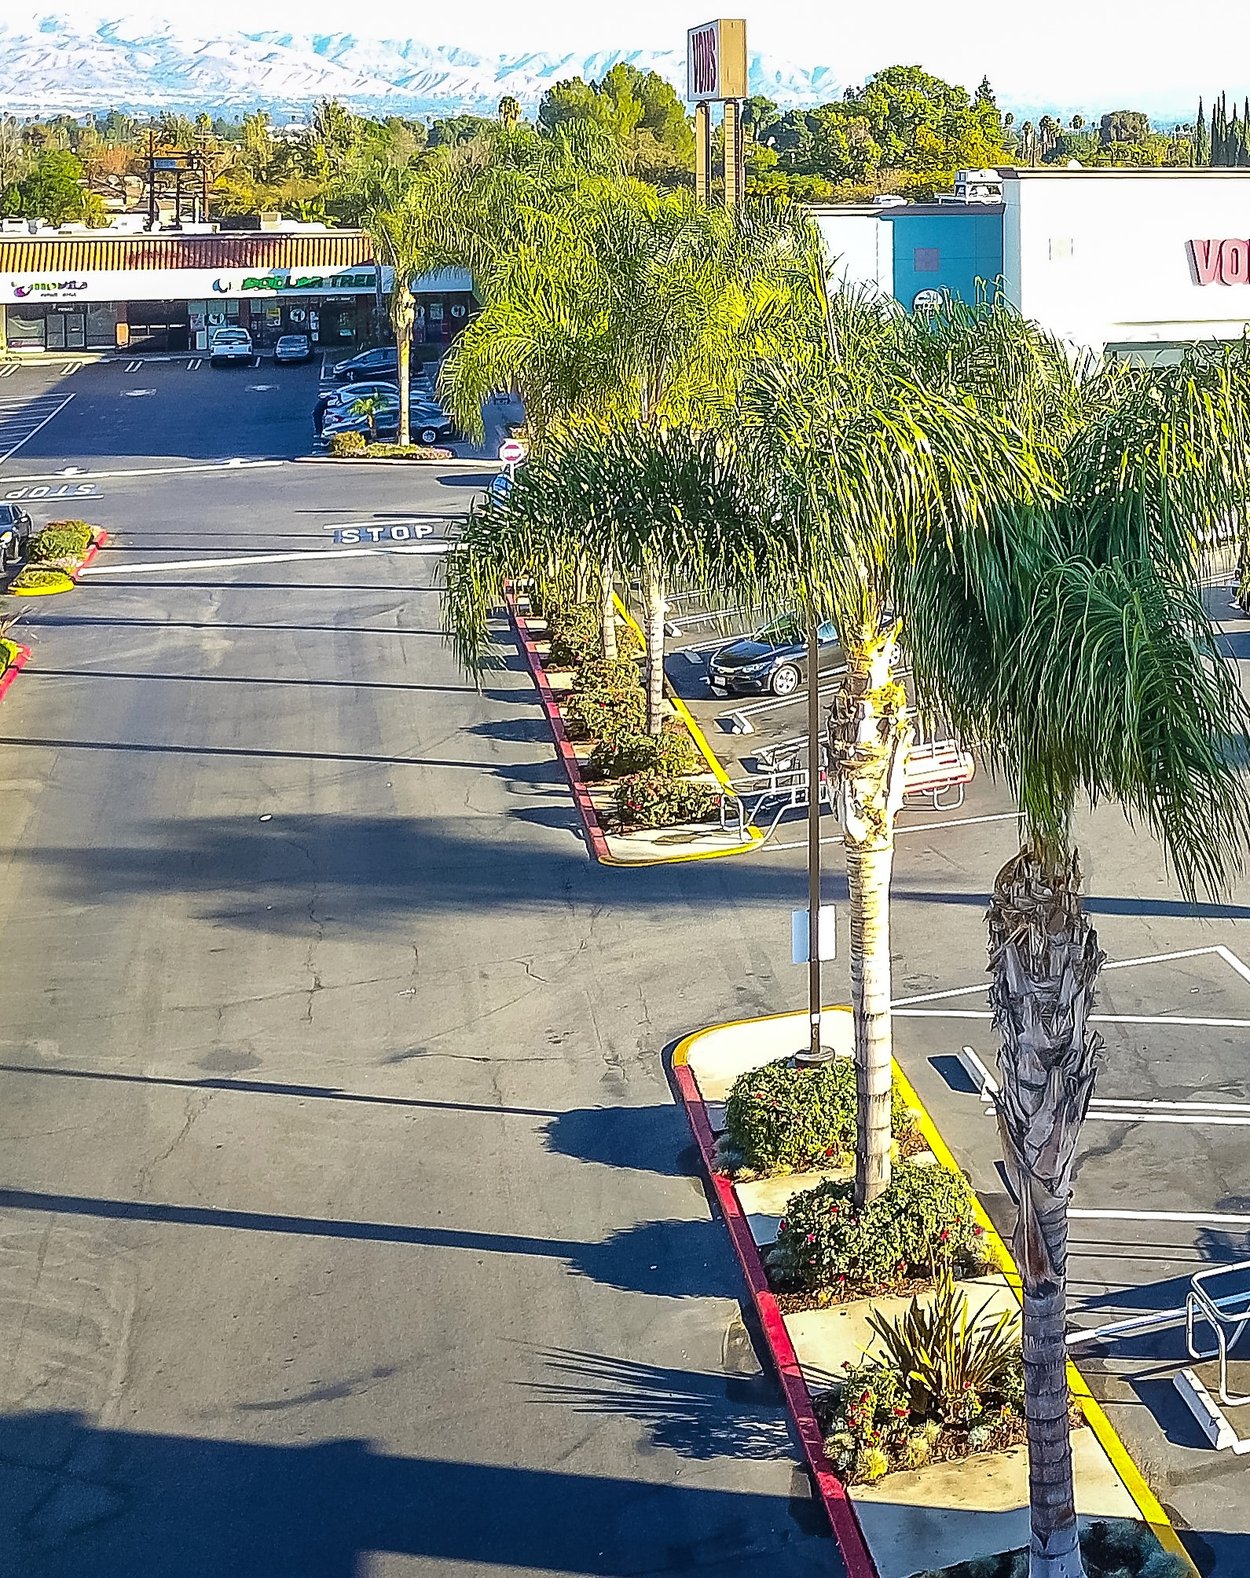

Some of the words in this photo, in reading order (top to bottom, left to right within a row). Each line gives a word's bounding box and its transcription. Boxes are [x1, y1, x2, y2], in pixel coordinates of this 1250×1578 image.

[692, 27, 716, 94] VONS
[4, 482, 97, 499] STOP
[340, 525, 434, 545] STOP
